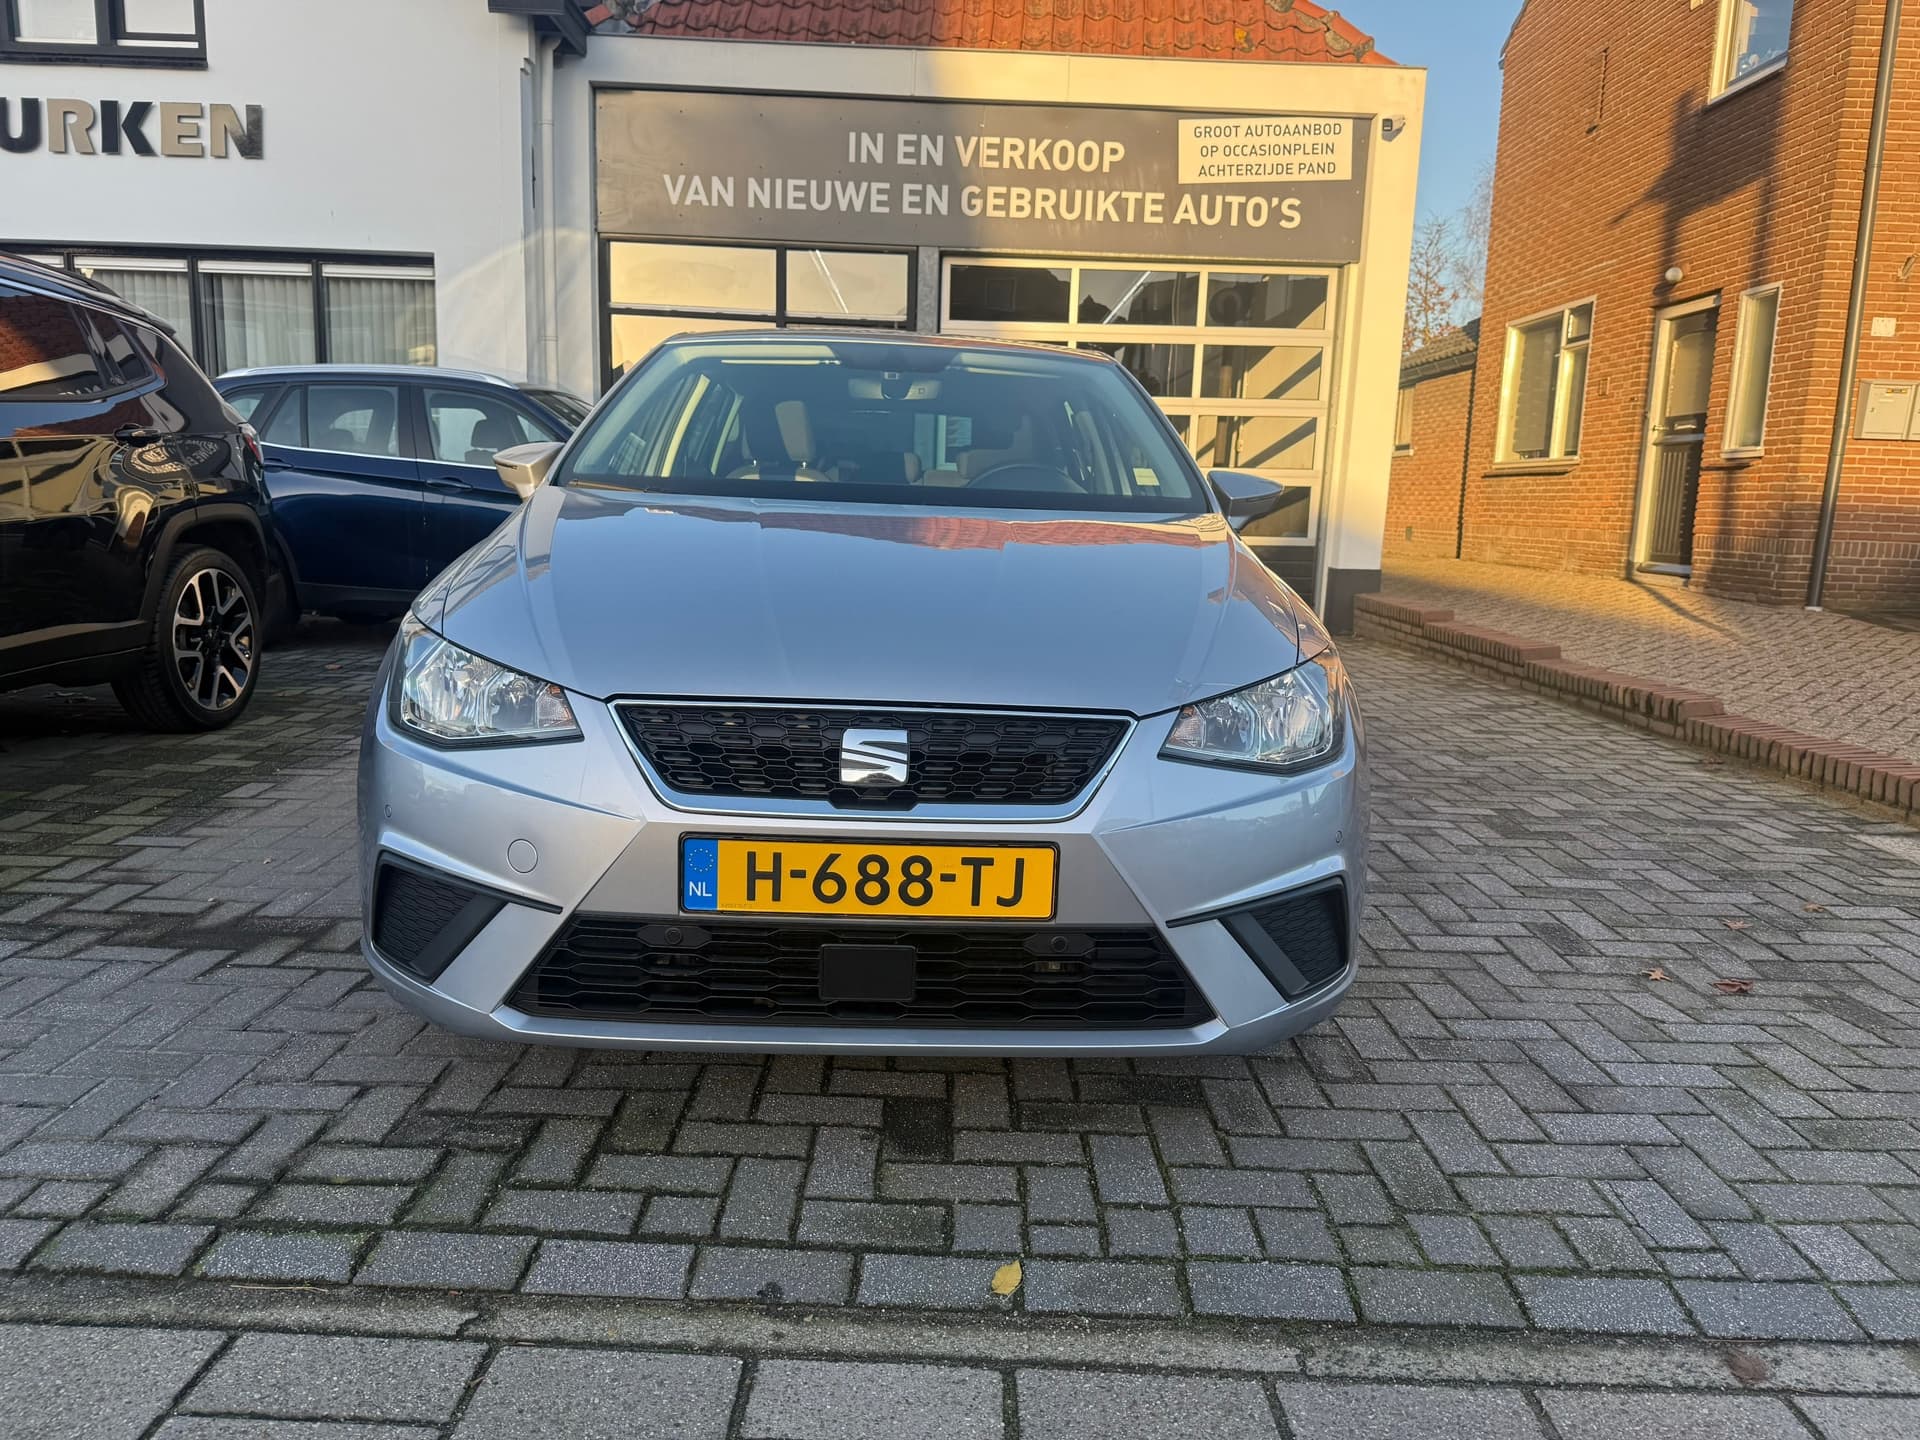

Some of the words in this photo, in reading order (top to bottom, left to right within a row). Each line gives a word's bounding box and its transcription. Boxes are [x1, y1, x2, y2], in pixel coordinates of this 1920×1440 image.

[0, 97, 264, 159] URKEN
[1193, 125, 1241, 138] GROOT
[1244, 123, 1342, 137] AUTOAANBOD
[848, 131, 884, 164] IN
[896, 133, 944, 166] EN
[954, 135, 1126, 173] VERKOOP
[1200, 145, 1219, 158] OP
[1223, 142, 1335, 157] OCCASIONPLEIN
[1198, 163, 1294, 177] ACHTERZIJDE
[1298, 162, 1336, 175] PAND
[663, 174, 735, 207] VAN
[747, 177, 891, 214] NIEUWE
[902, 183, 949, 216] EN
[960, 185, 1166, 225] GEBRUIKTE
[1172, 193, 1302, 230] AUTO'S
[689, 881, 712, 898] NL
[746, 851, 1025, 907] H-688-TJ
